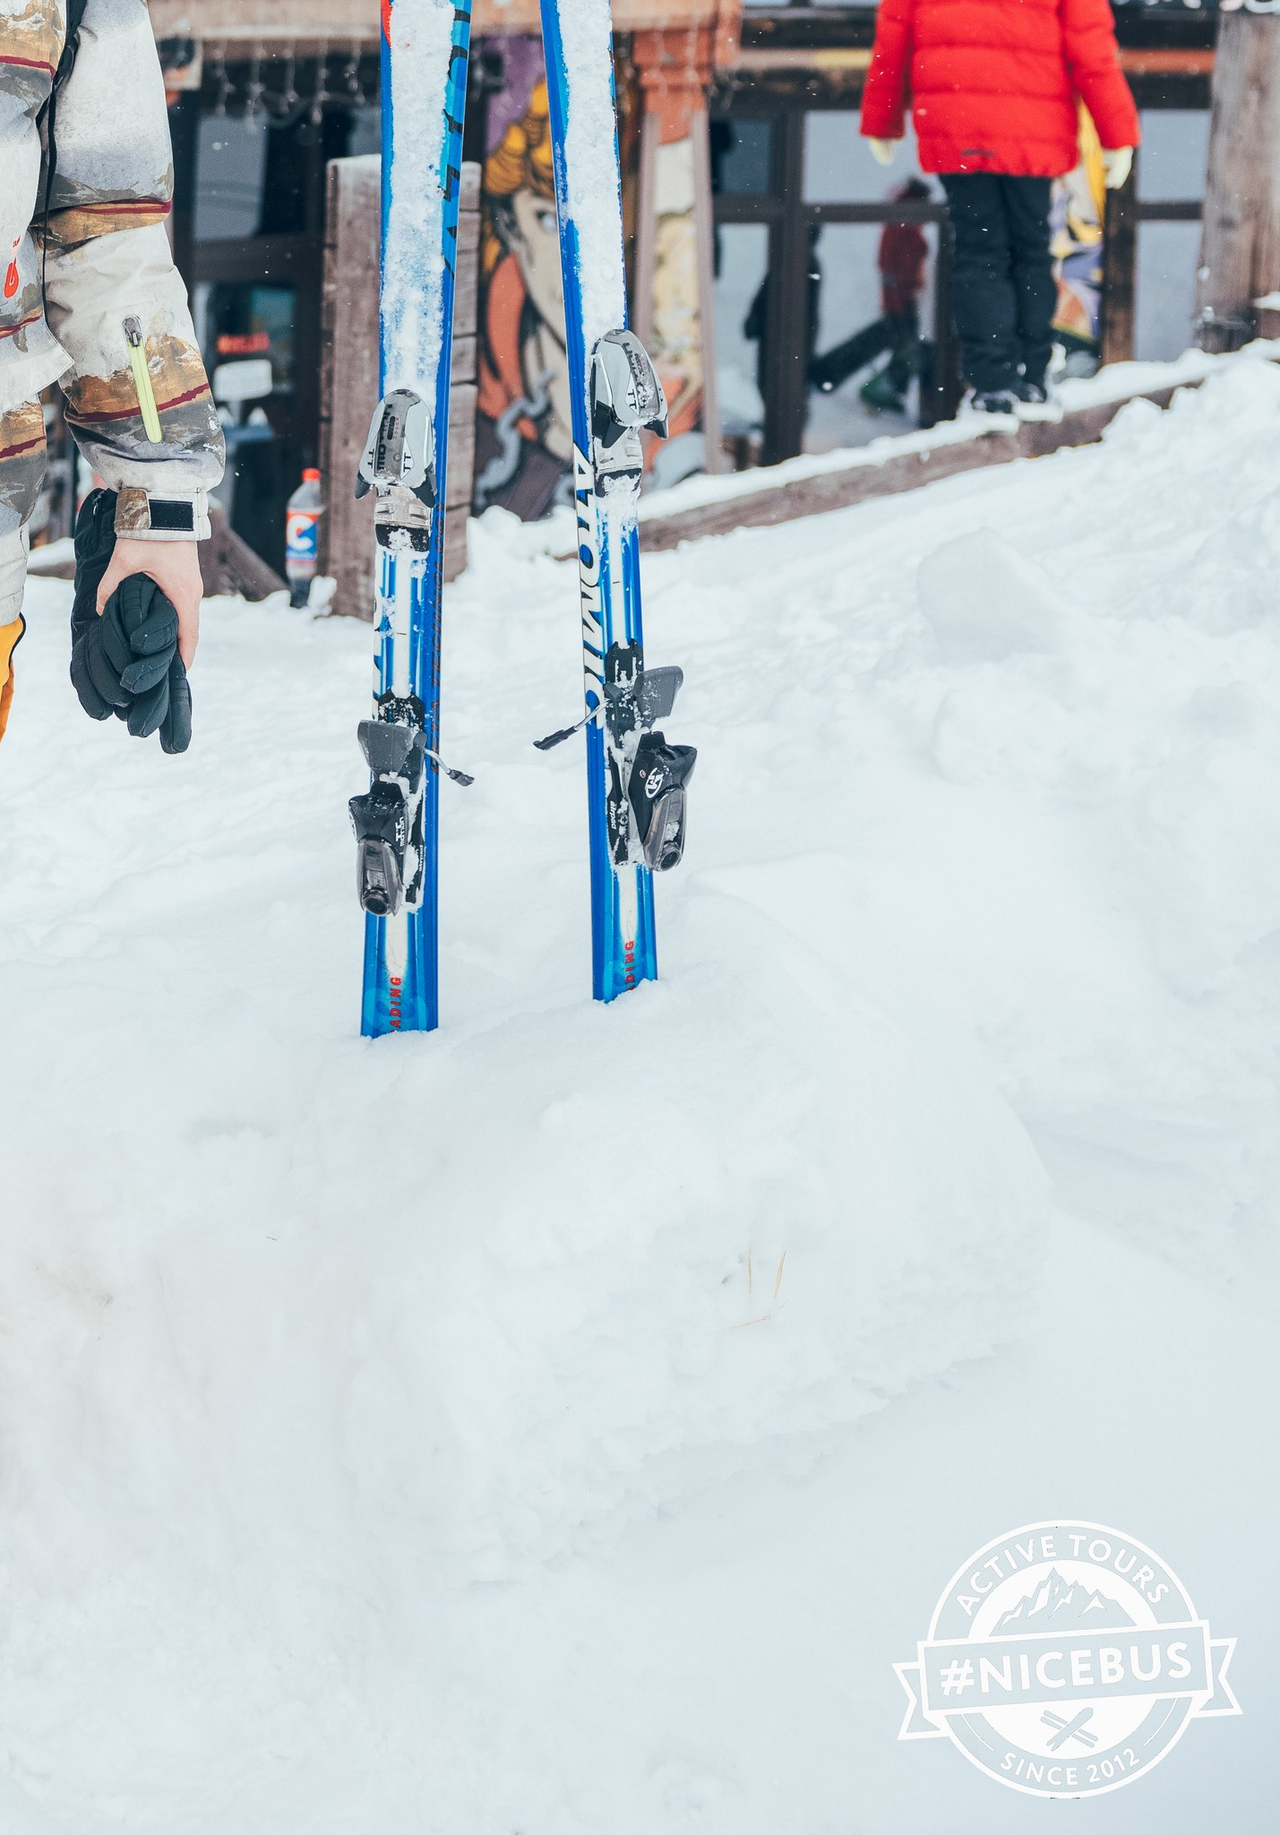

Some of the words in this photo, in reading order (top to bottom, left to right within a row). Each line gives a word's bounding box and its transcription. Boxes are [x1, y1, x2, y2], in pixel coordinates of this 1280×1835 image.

[573, 441, 606, 730] ATOMIC
[623, 940, 635, 992] DING
[389, 976, 402, 1033] ADING
